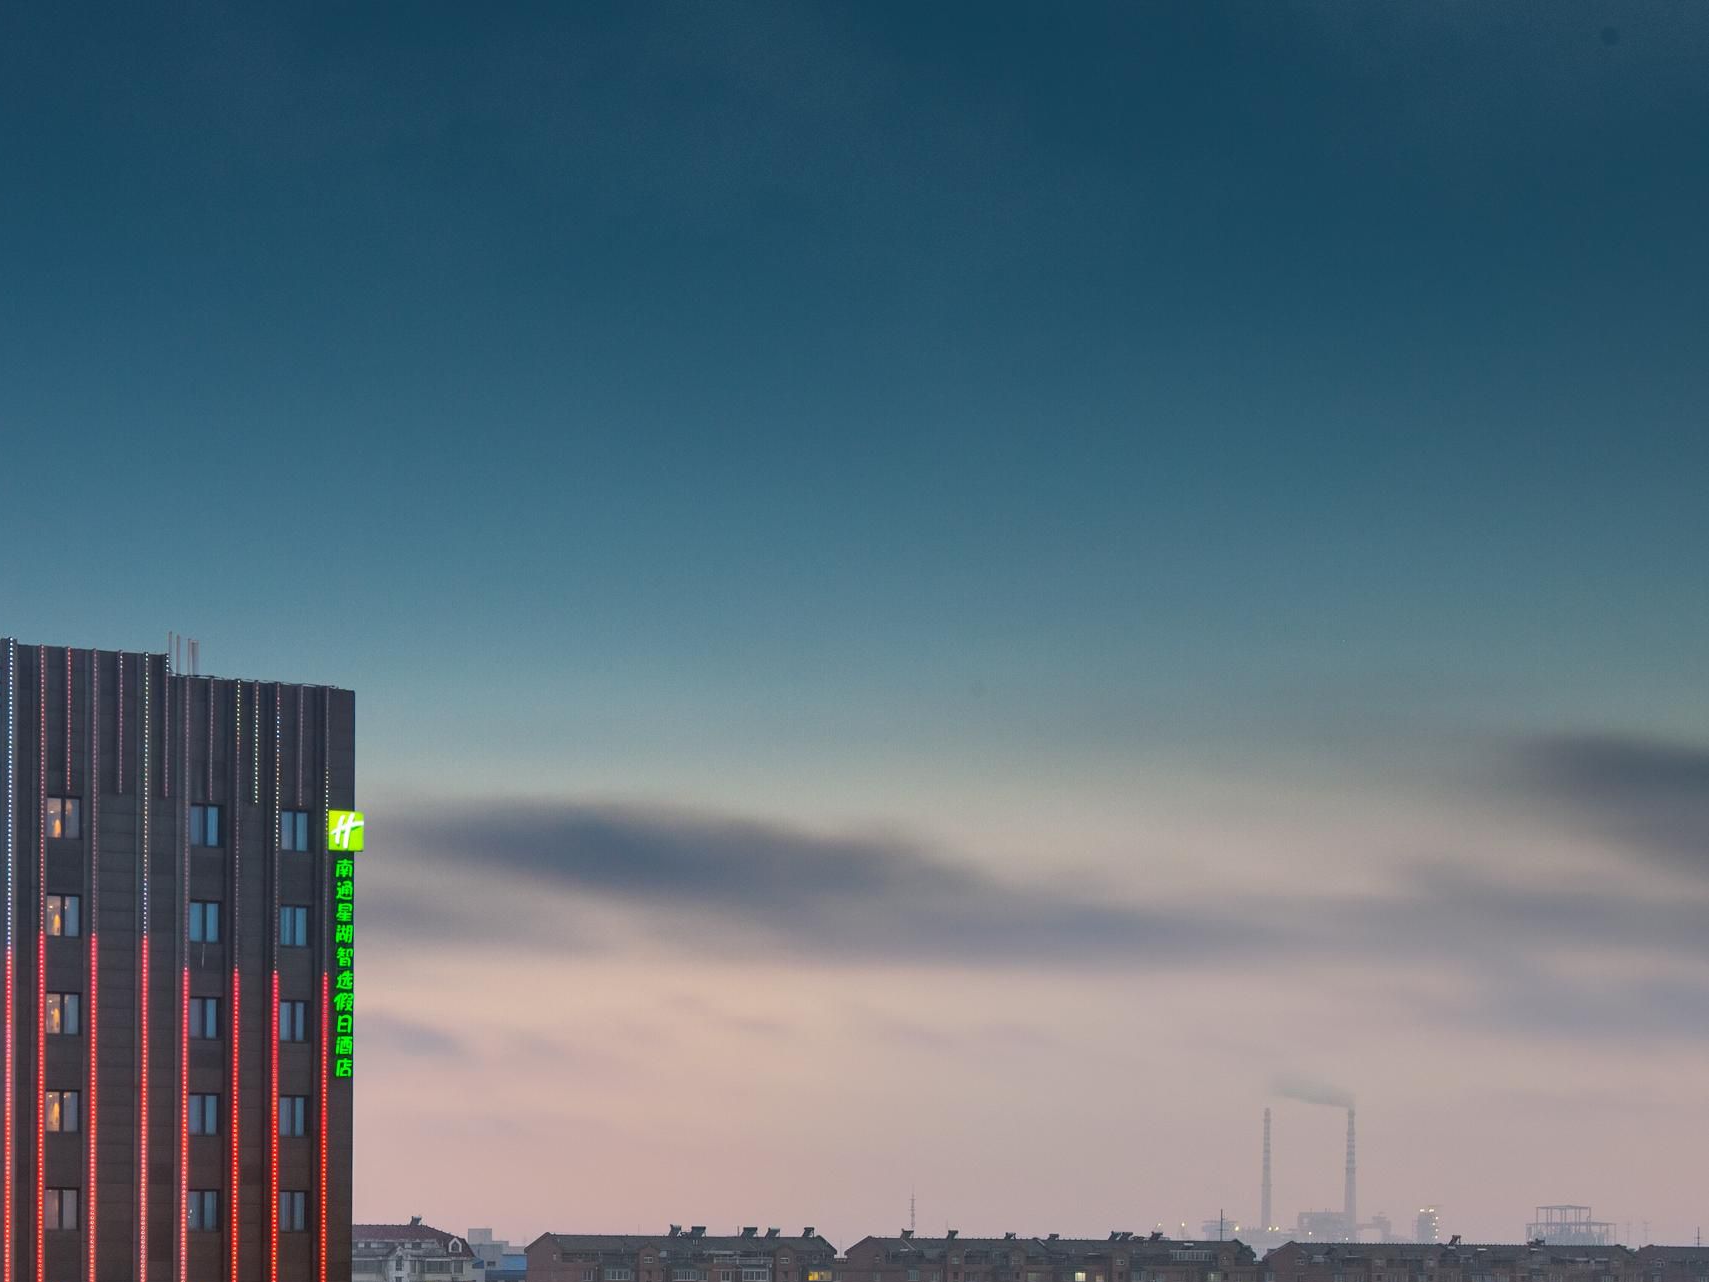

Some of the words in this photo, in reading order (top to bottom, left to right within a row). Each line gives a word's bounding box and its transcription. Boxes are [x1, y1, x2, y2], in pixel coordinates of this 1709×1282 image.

[334, 858, 354, 1079] 南通星湖智选假日酒店
